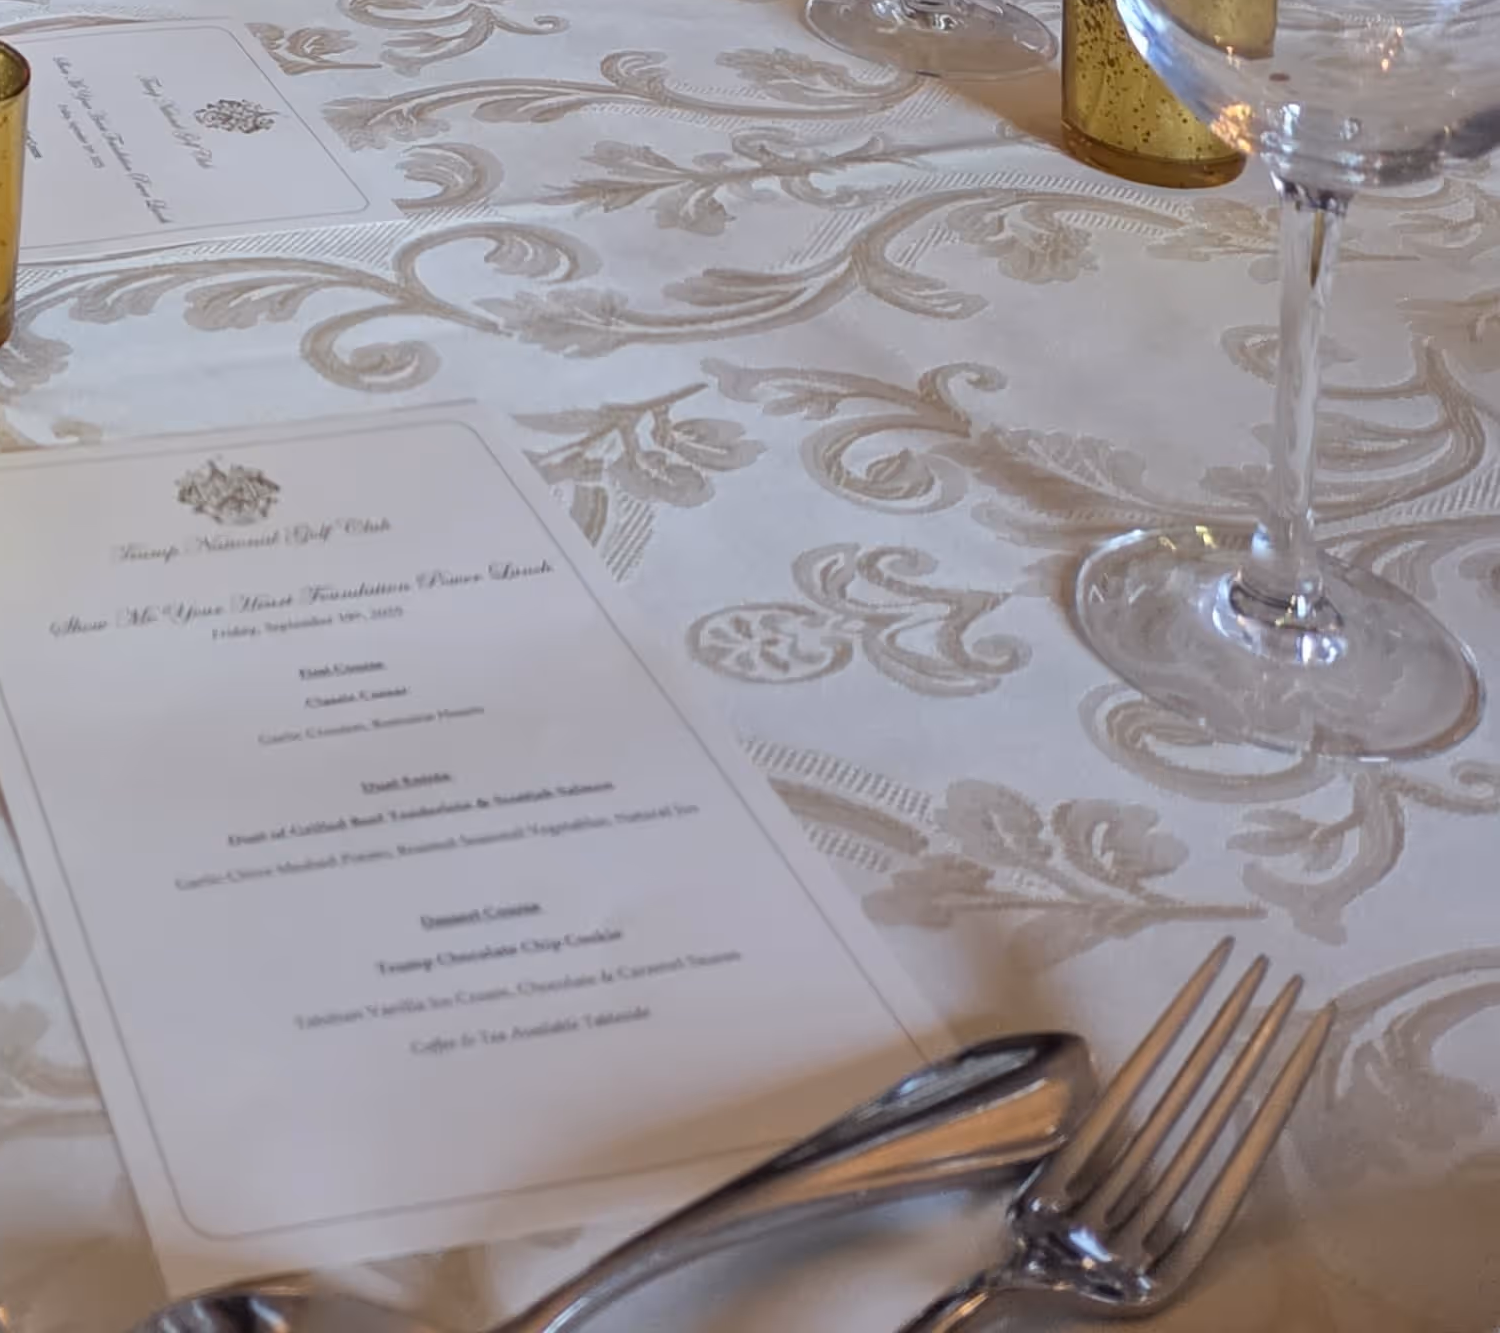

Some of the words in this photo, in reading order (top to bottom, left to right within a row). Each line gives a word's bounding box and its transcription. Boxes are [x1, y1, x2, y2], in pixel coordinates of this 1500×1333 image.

[284, 524, 333, 545] Golf
[335, 517, 391, 534] Club
[300, 581, 411, 606] Foundation
